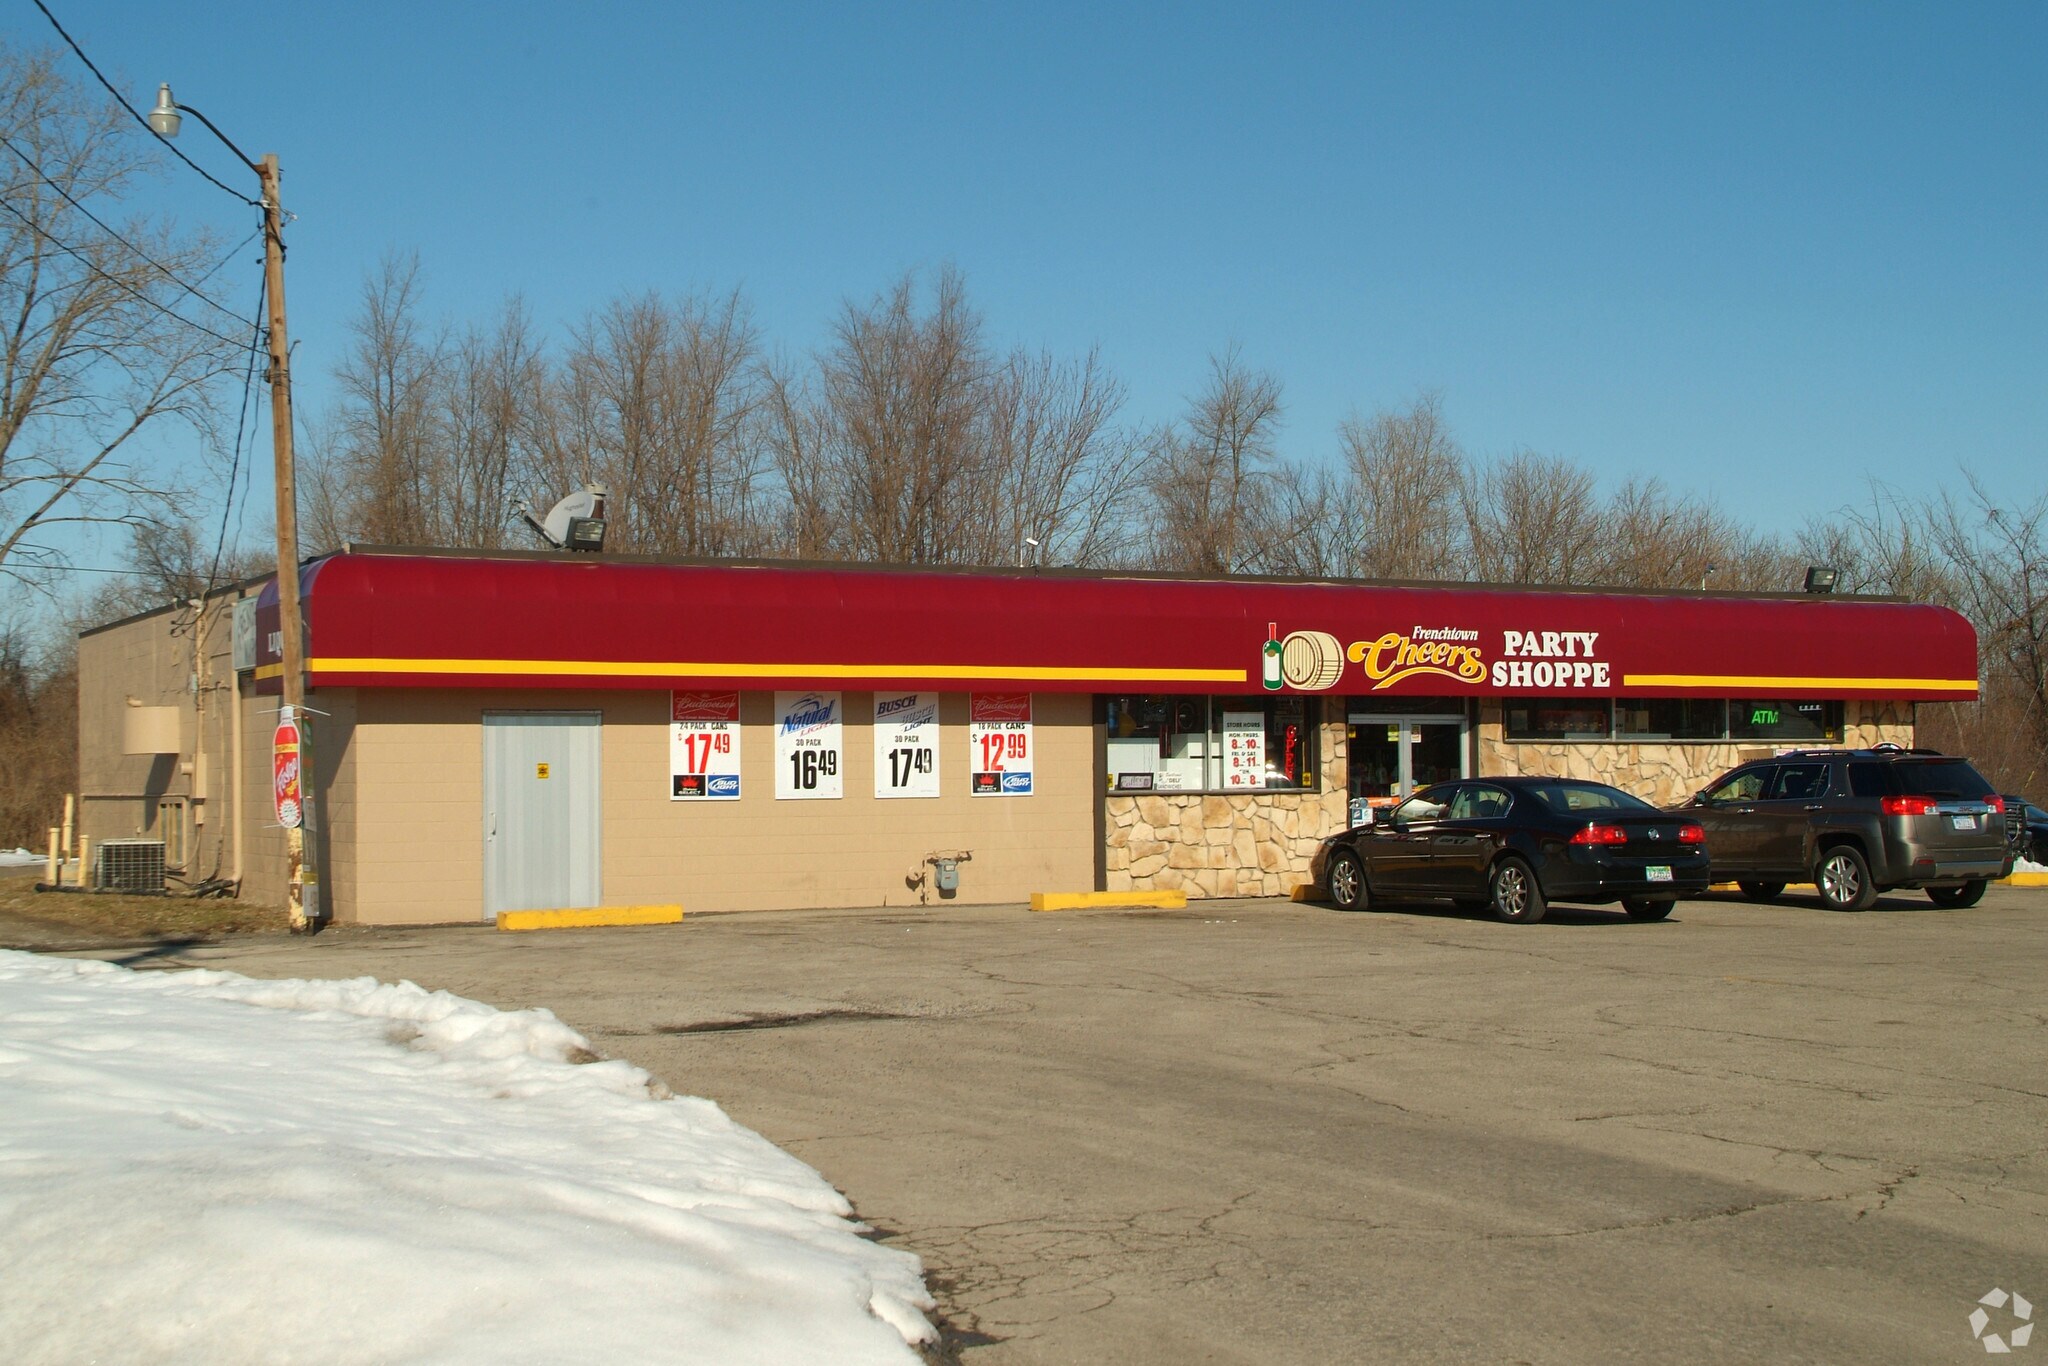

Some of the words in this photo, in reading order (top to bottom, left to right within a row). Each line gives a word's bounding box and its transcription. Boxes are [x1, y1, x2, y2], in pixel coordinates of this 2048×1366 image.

[1412, 626, 1478, 640] Frenchtown
[1503, 630, 1599, 657] PARTY
[1347, 632, 1485, 682] Cheers
[1492, 661, 1610, 687] SHOPPE
[877, 695, 918, 715] BUSCH
[680, 722, 688, 730] 24
[690, 722, 706, 730] PACK
[711, 722, 728, 730] CANS
[780, 699, 836, 737] Natural
[904, 716, 933, 732] LIGHT
[1751, 710, 1779, 724] ATM
[800, 718, 837, 737] LIGHT
